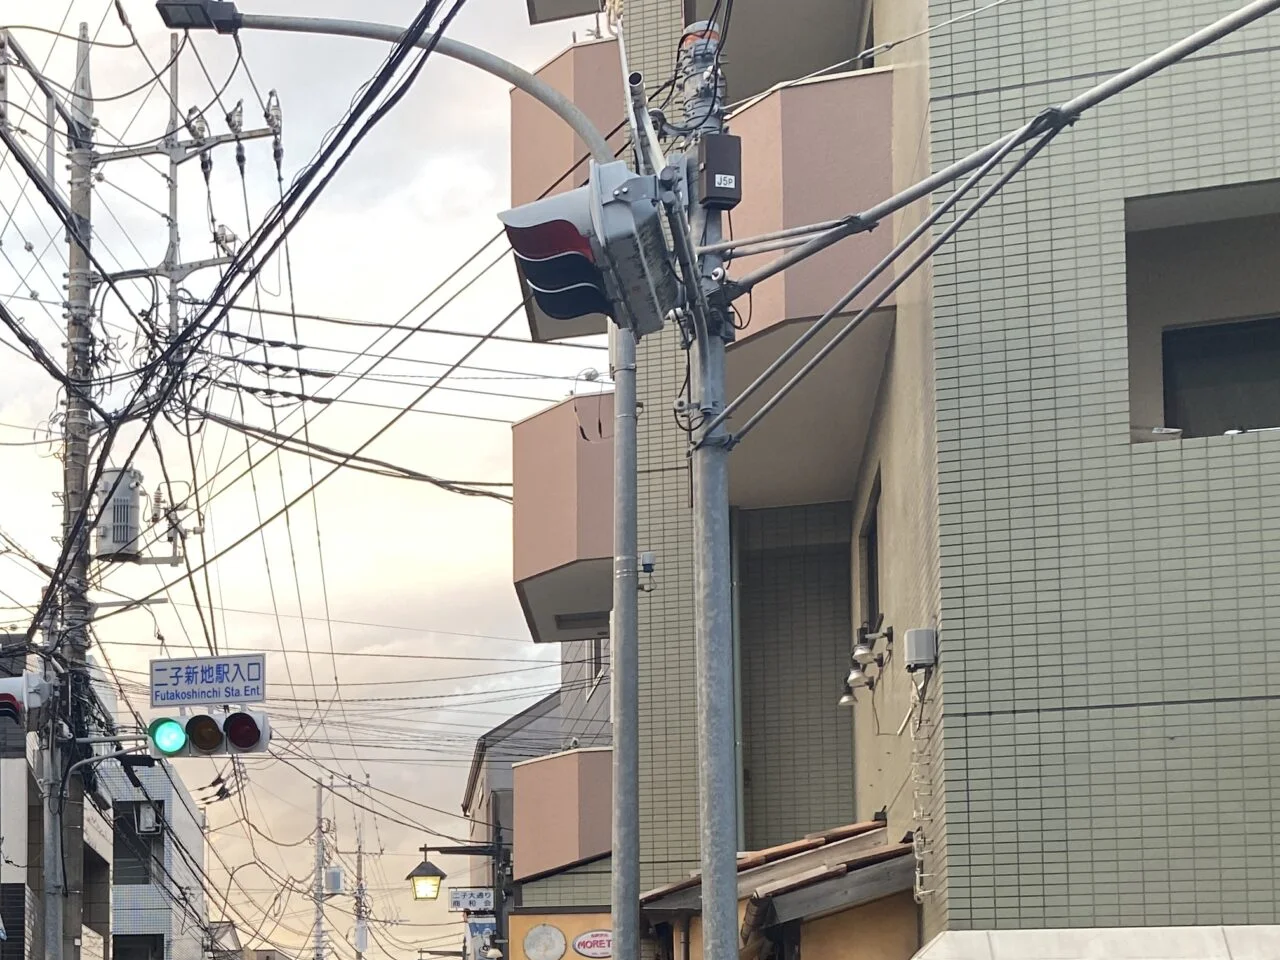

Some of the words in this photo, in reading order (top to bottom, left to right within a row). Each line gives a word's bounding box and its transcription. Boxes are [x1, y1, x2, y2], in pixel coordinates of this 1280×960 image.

[154, 662, 261, 687] 二子新地駅入口
[154, 687, 220, 701] Futakoshinchi
[224, 686, 242, 698] Sta.
[452, 891, 492, 899] 二子大通り
[577, 939, 612, 950] MORET
